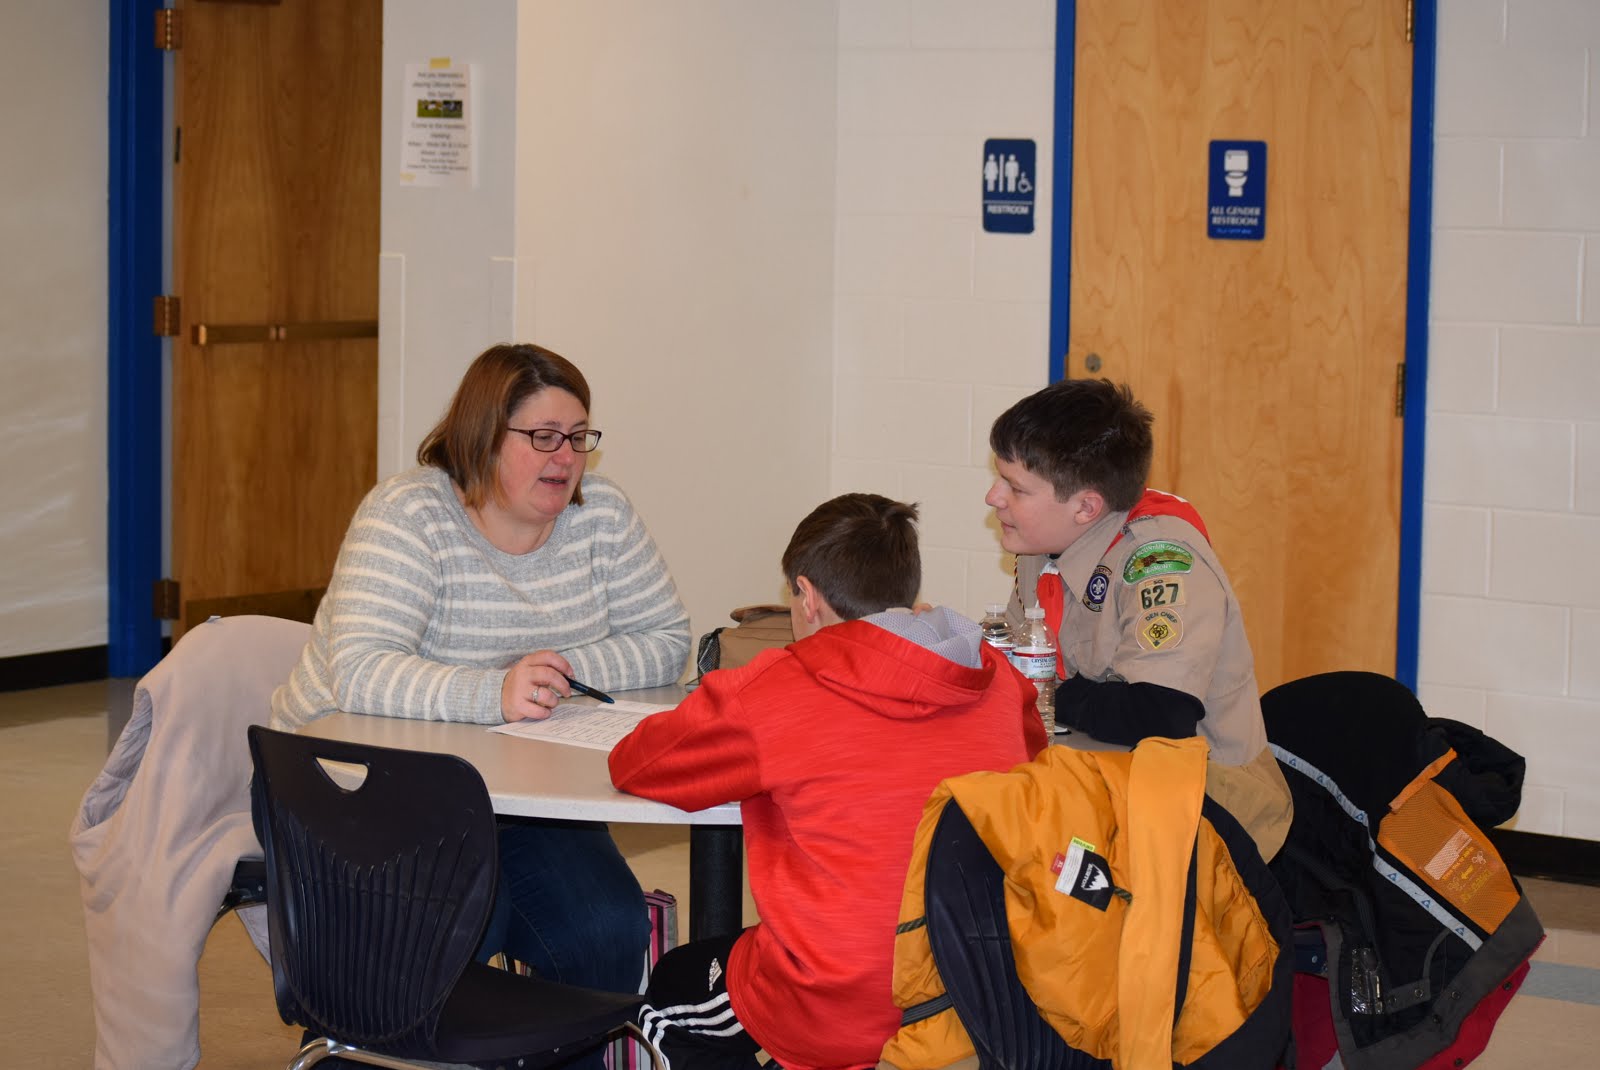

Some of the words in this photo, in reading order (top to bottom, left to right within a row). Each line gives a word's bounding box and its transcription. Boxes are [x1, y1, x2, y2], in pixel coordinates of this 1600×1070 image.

[987, 205, 1029, 215] RESTROOM
[1210, 206, 1224, 215] ALL
[1226, 206, 1261, 216] GENDER
[1211, 216, 1259, 226] RESTROOM
[1141, 583, 1179, 610] 627
[1145, 611, 1159, 622] DEN
[1160, 611, 1178, 624] CHIEF
[1080, 863, 1094, 889] BURTON
